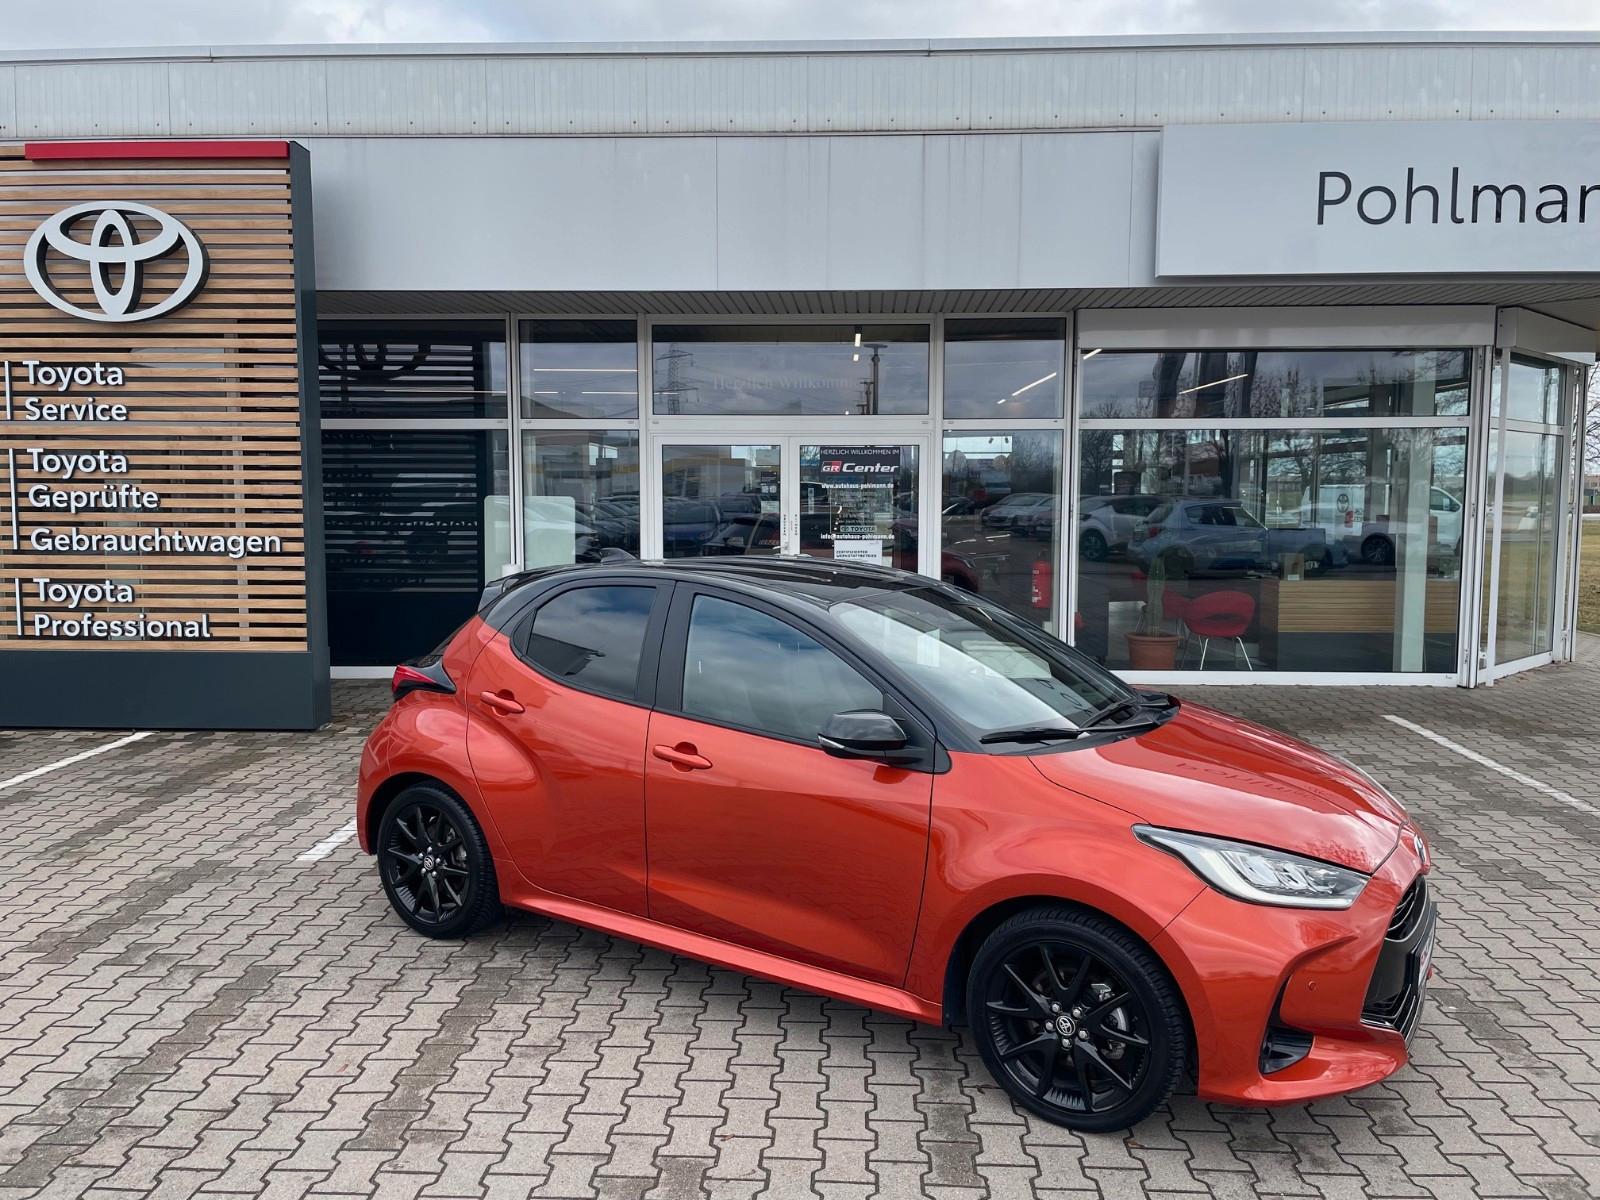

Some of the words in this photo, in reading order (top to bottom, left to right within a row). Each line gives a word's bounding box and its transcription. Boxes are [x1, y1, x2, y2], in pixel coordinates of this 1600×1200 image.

[23, 360, 124, 391] Toyota
[25, 397, 127, 420] Service
[27, 448, 128, 479] Toyota
[842, 463, 899, 472] Center
[28, 484, 160, 513] Geprüfte
[30, 528, 282, 559] Gebrauchtwagen
[33, 578, 133, 608] Toyota
[34, 613, 211, 637] Professional
